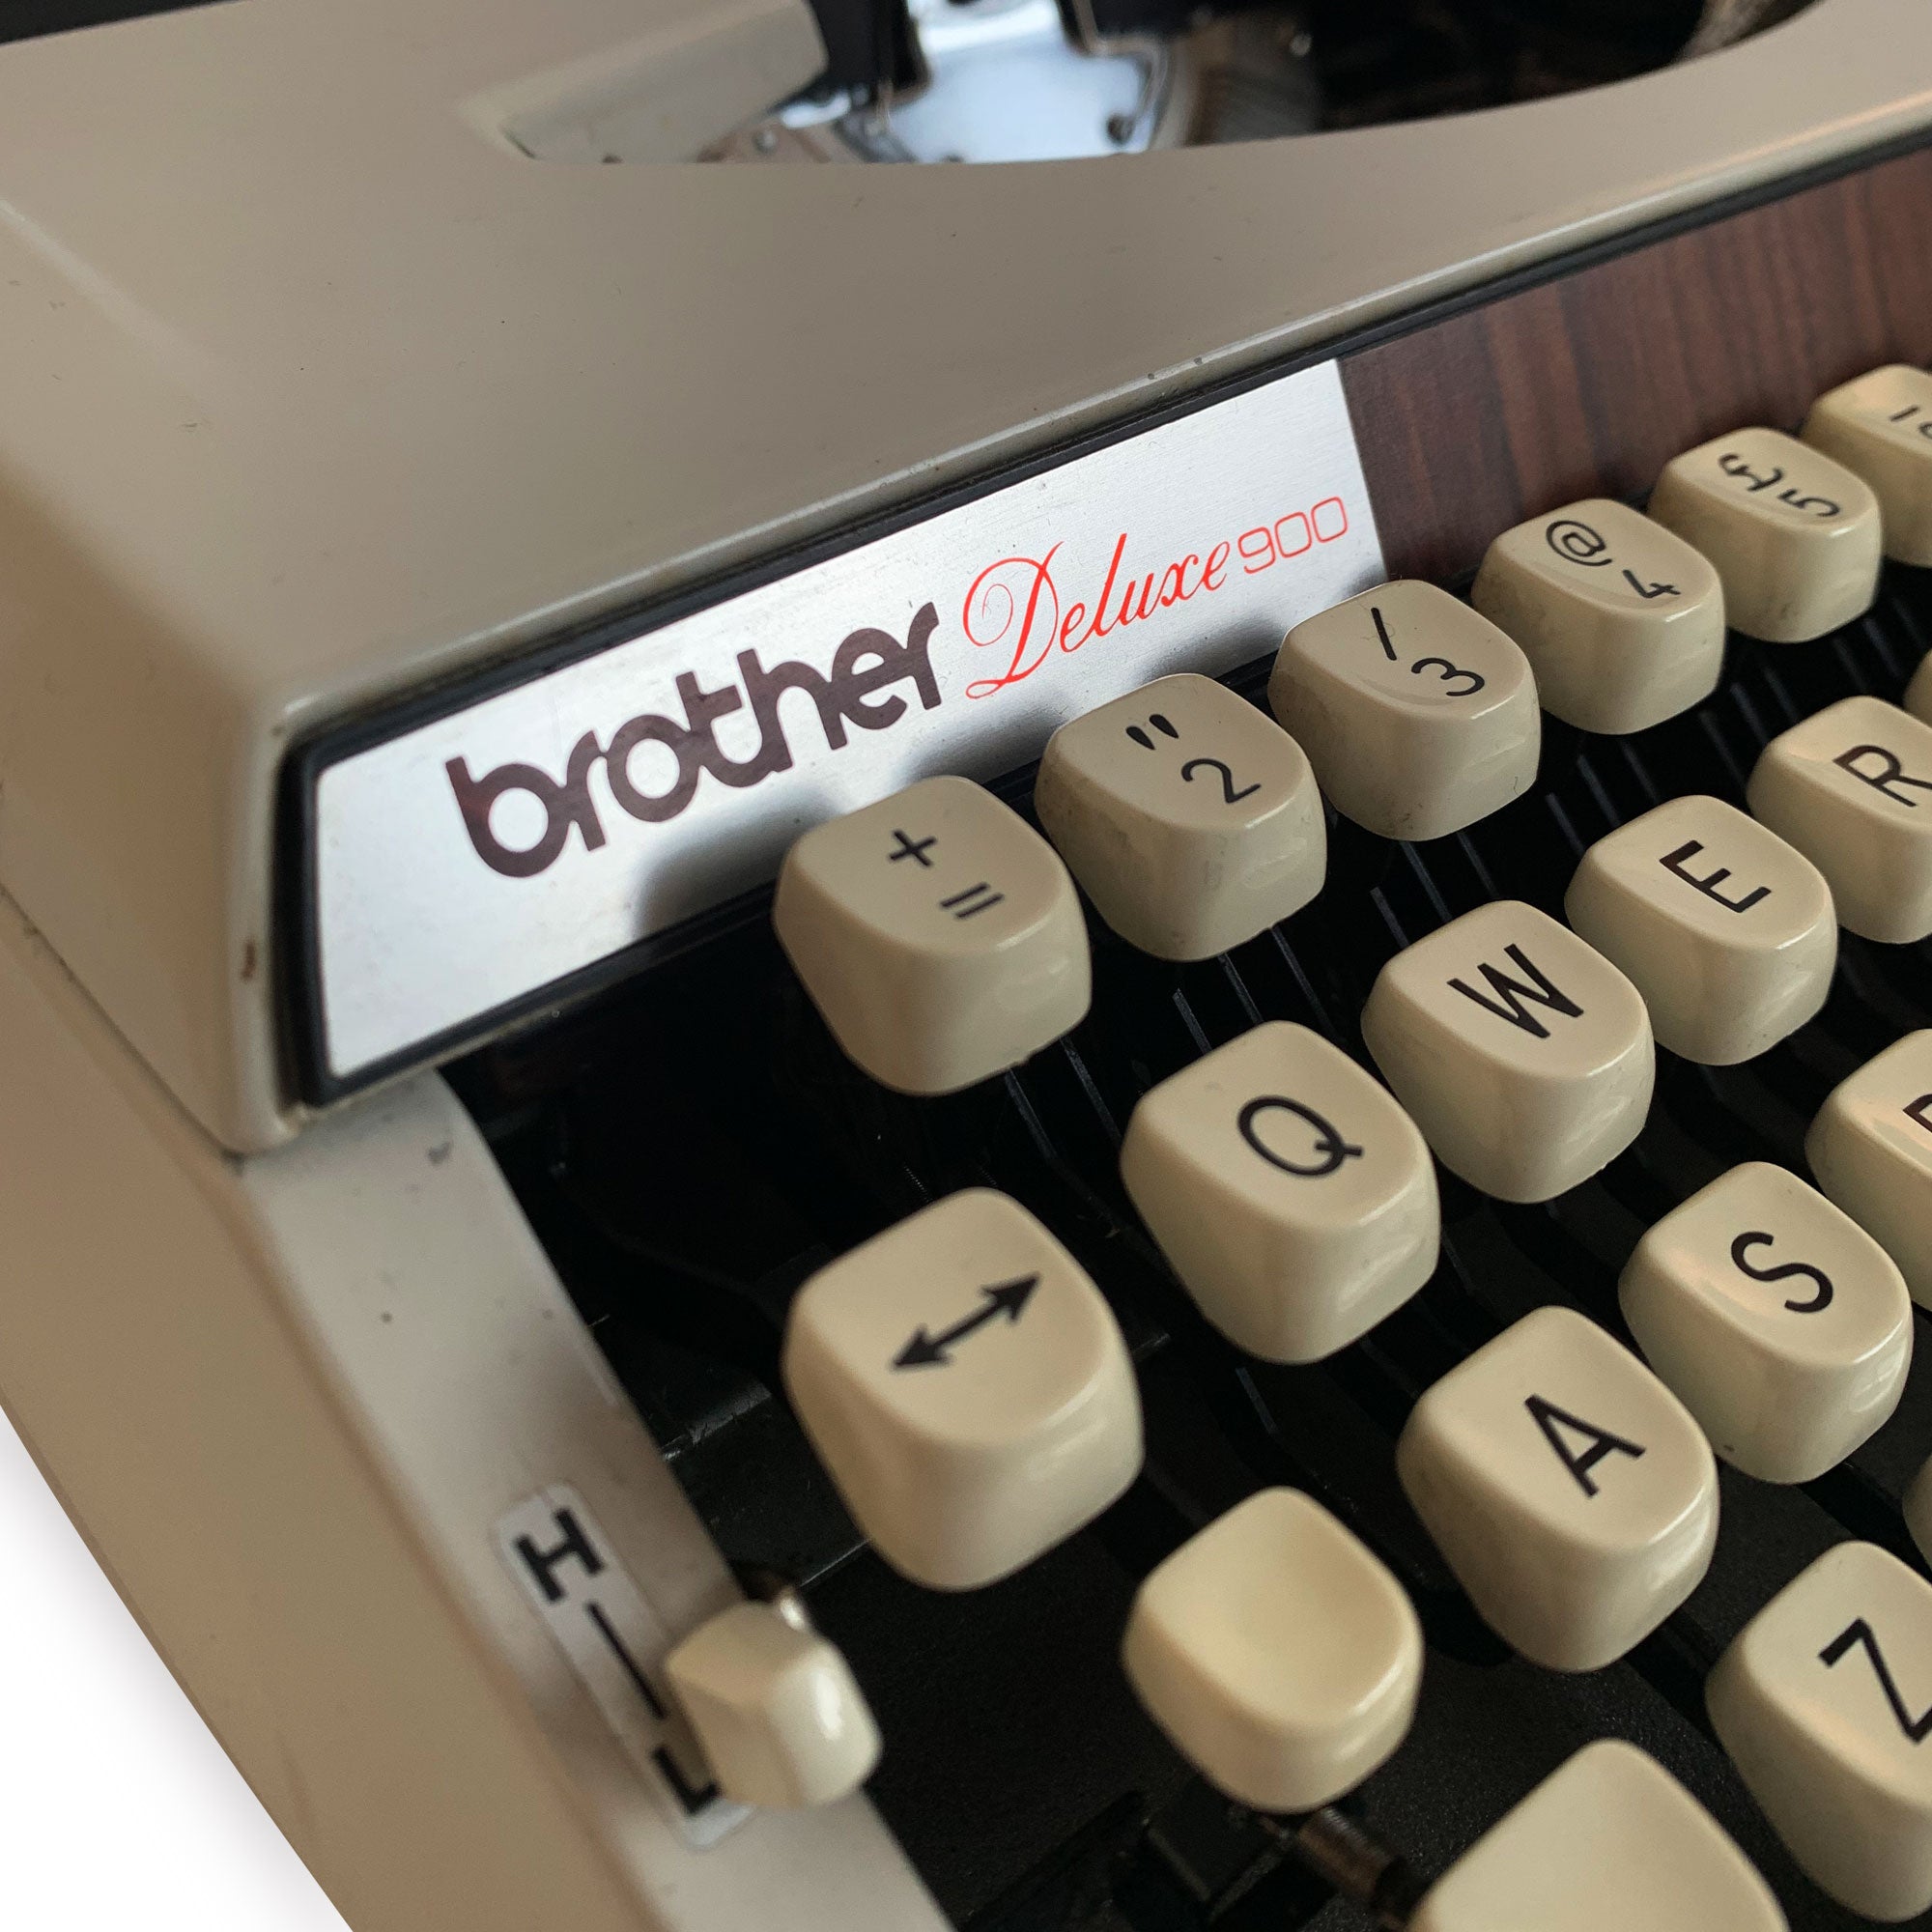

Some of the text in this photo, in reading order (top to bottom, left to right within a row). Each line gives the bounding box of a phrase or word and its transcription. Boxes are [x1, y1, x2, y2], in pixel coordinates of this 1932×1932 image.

[1718, 453, 1785, 493] £
[1776, 488, 1842, 519] 5
[1546, 519, 1614, 568] @
[1622, 568, 1682, 600] 4
[443, 497, 1349, 879] brother Deluxe 900
[1409, 656, 1487, 698] 3
[1179, 756, 1263, 806] 2
[1833, 744, 1932, 808] R
[888, 829, 938, 868] +
[1658, 838, 1773, 915] E
[939, 882, 1005, 921] =
[1445, 942, 1585, 1040] W
[1236, 1094, 1364, 1179] Q
[1729, 1230, 1835, 1315] S
[1523, 1394, 1647, 1499] A
[514, 1507, 606, 1604] H
[1817, 1616, 1932, 1745] Z
[649, 1741, 723, 1816] L
